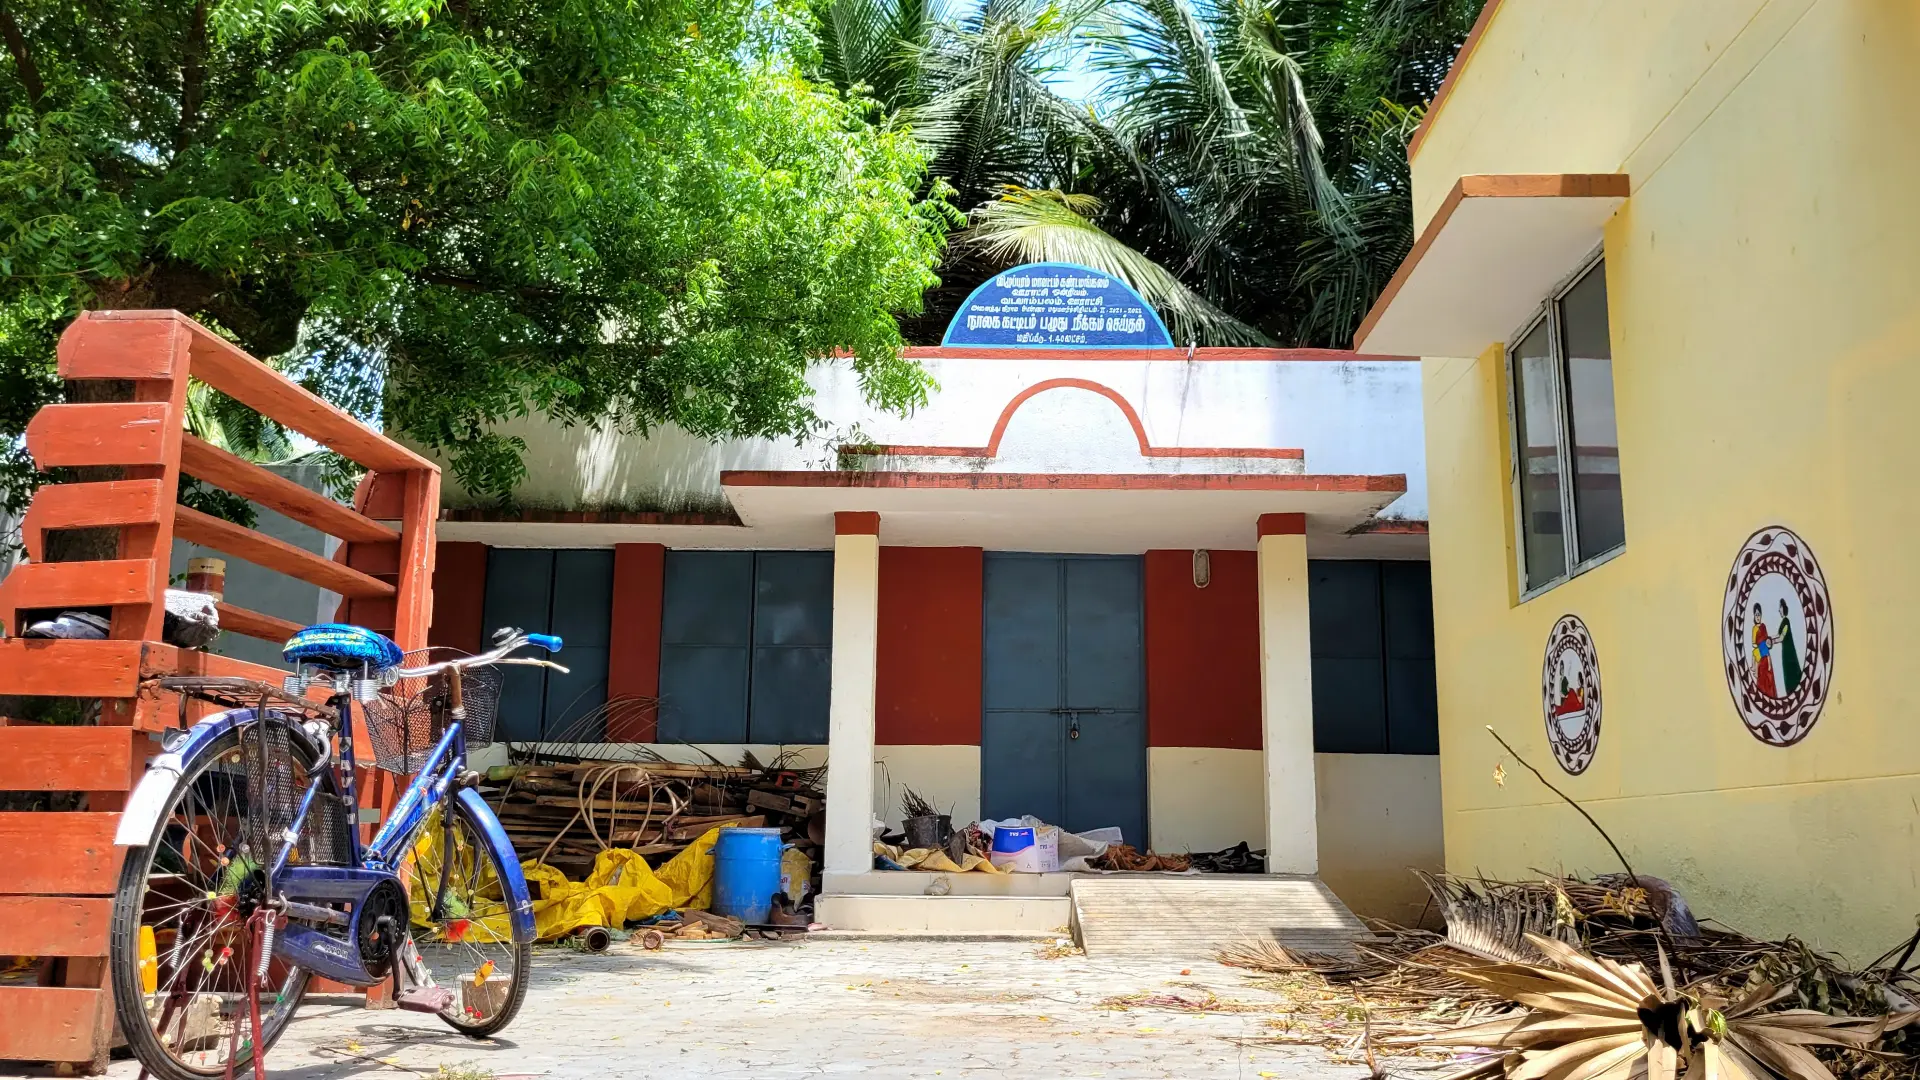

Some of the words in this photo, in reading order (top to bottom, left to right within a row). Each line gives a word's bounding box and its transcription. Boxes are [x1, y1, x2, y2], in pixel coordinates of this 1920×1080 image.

[1002, 313, 1036, 331] கட்டிடம்
[1040, 317, 1068, 333] பழுது
[1071, 314, 1104, 331] நீக்கம்
[1106, 315, 1145, 333] செய்தல்
